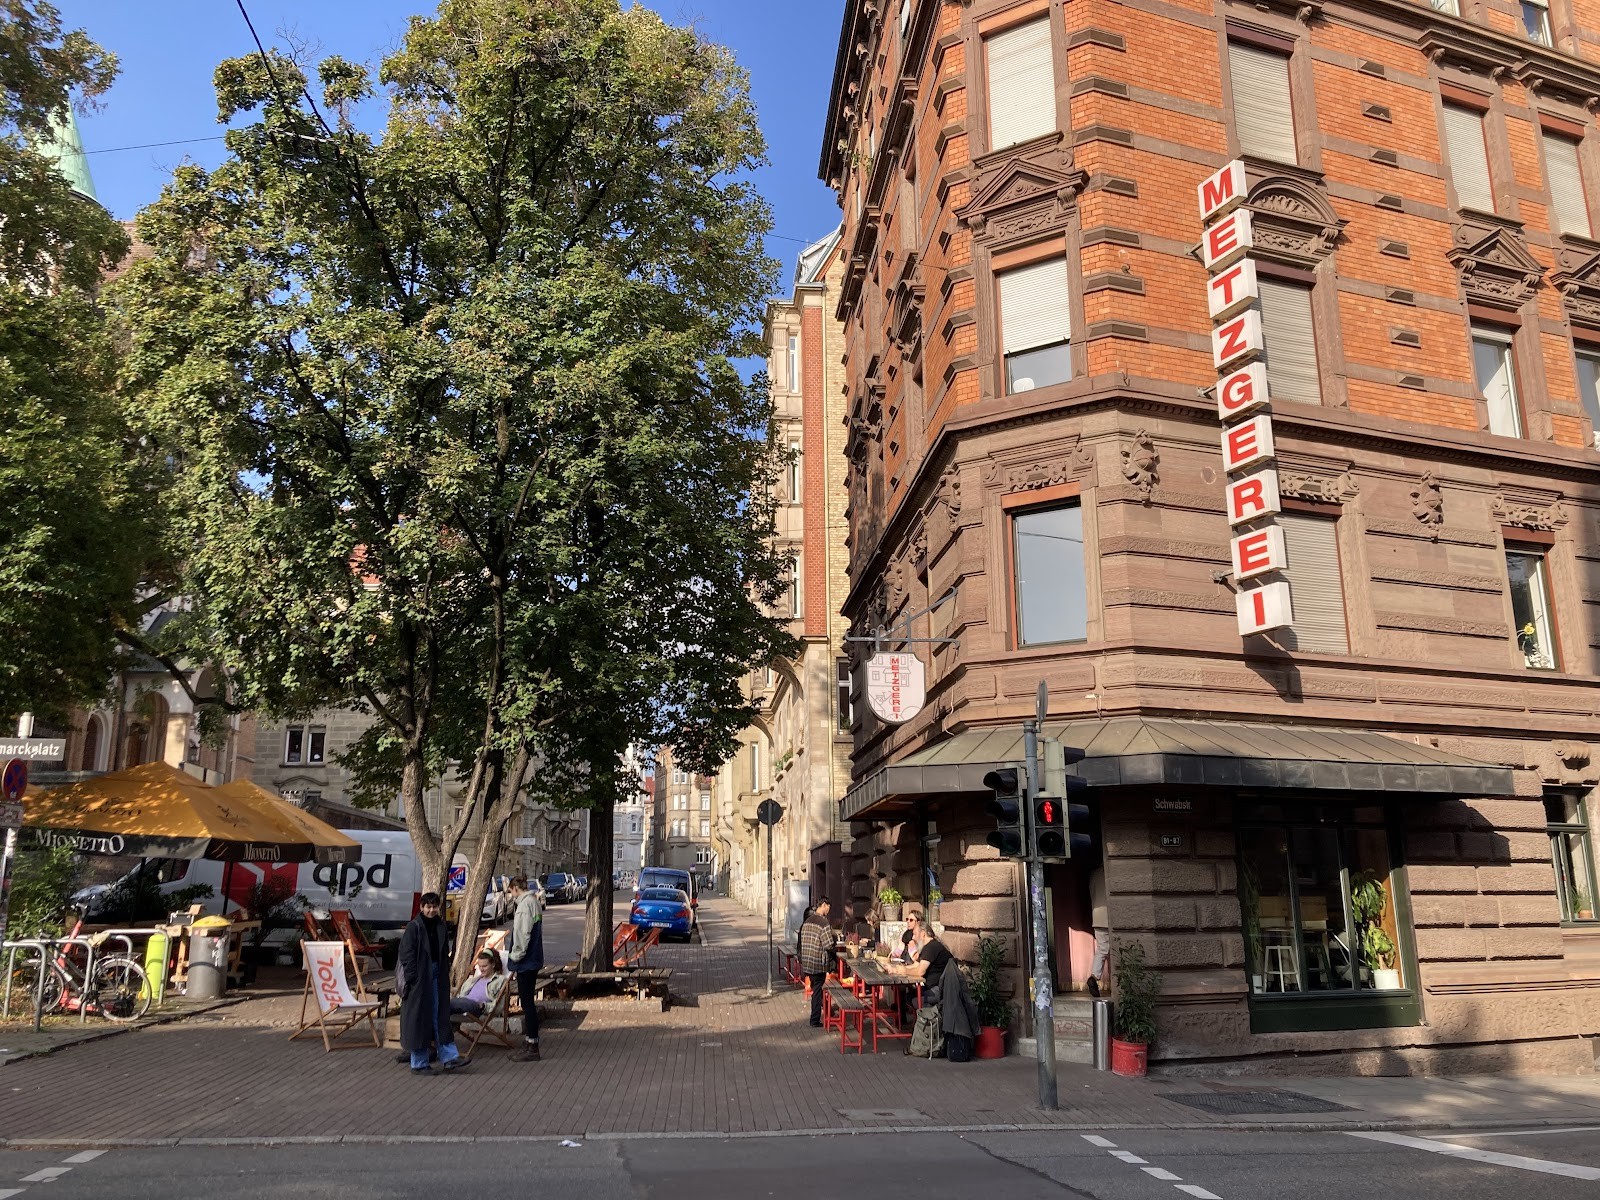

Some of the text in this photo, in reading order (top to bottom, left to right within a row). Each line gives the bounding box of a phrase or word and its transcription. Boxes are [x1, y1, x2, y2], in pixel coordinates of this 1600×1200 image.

[1203, 167, 1270, 626] METZGEREI
[891, 658, 901, 719] METZGEREI
[1154, 798, 1193, 810] Schwabstr.
